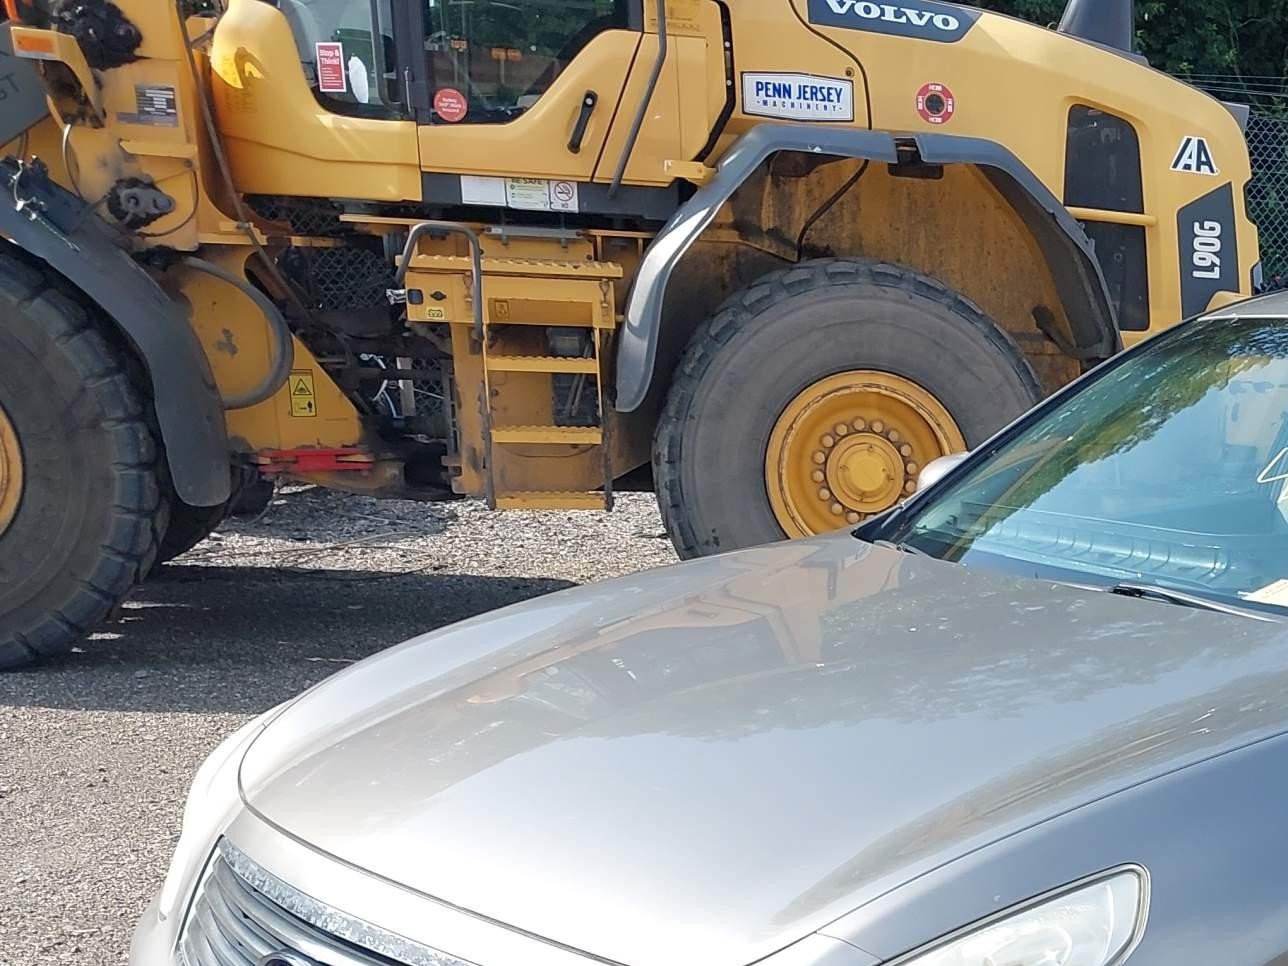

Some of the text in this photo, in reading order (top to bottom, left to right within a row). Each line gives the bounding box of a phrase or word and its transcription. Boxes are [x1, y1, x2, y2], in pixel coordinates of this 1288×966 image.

[825, 0, 959, 31] VOLVO
[755, 81, 843, 113] PENN JERSEY
[1192, 220, 1222, 279] L90G
